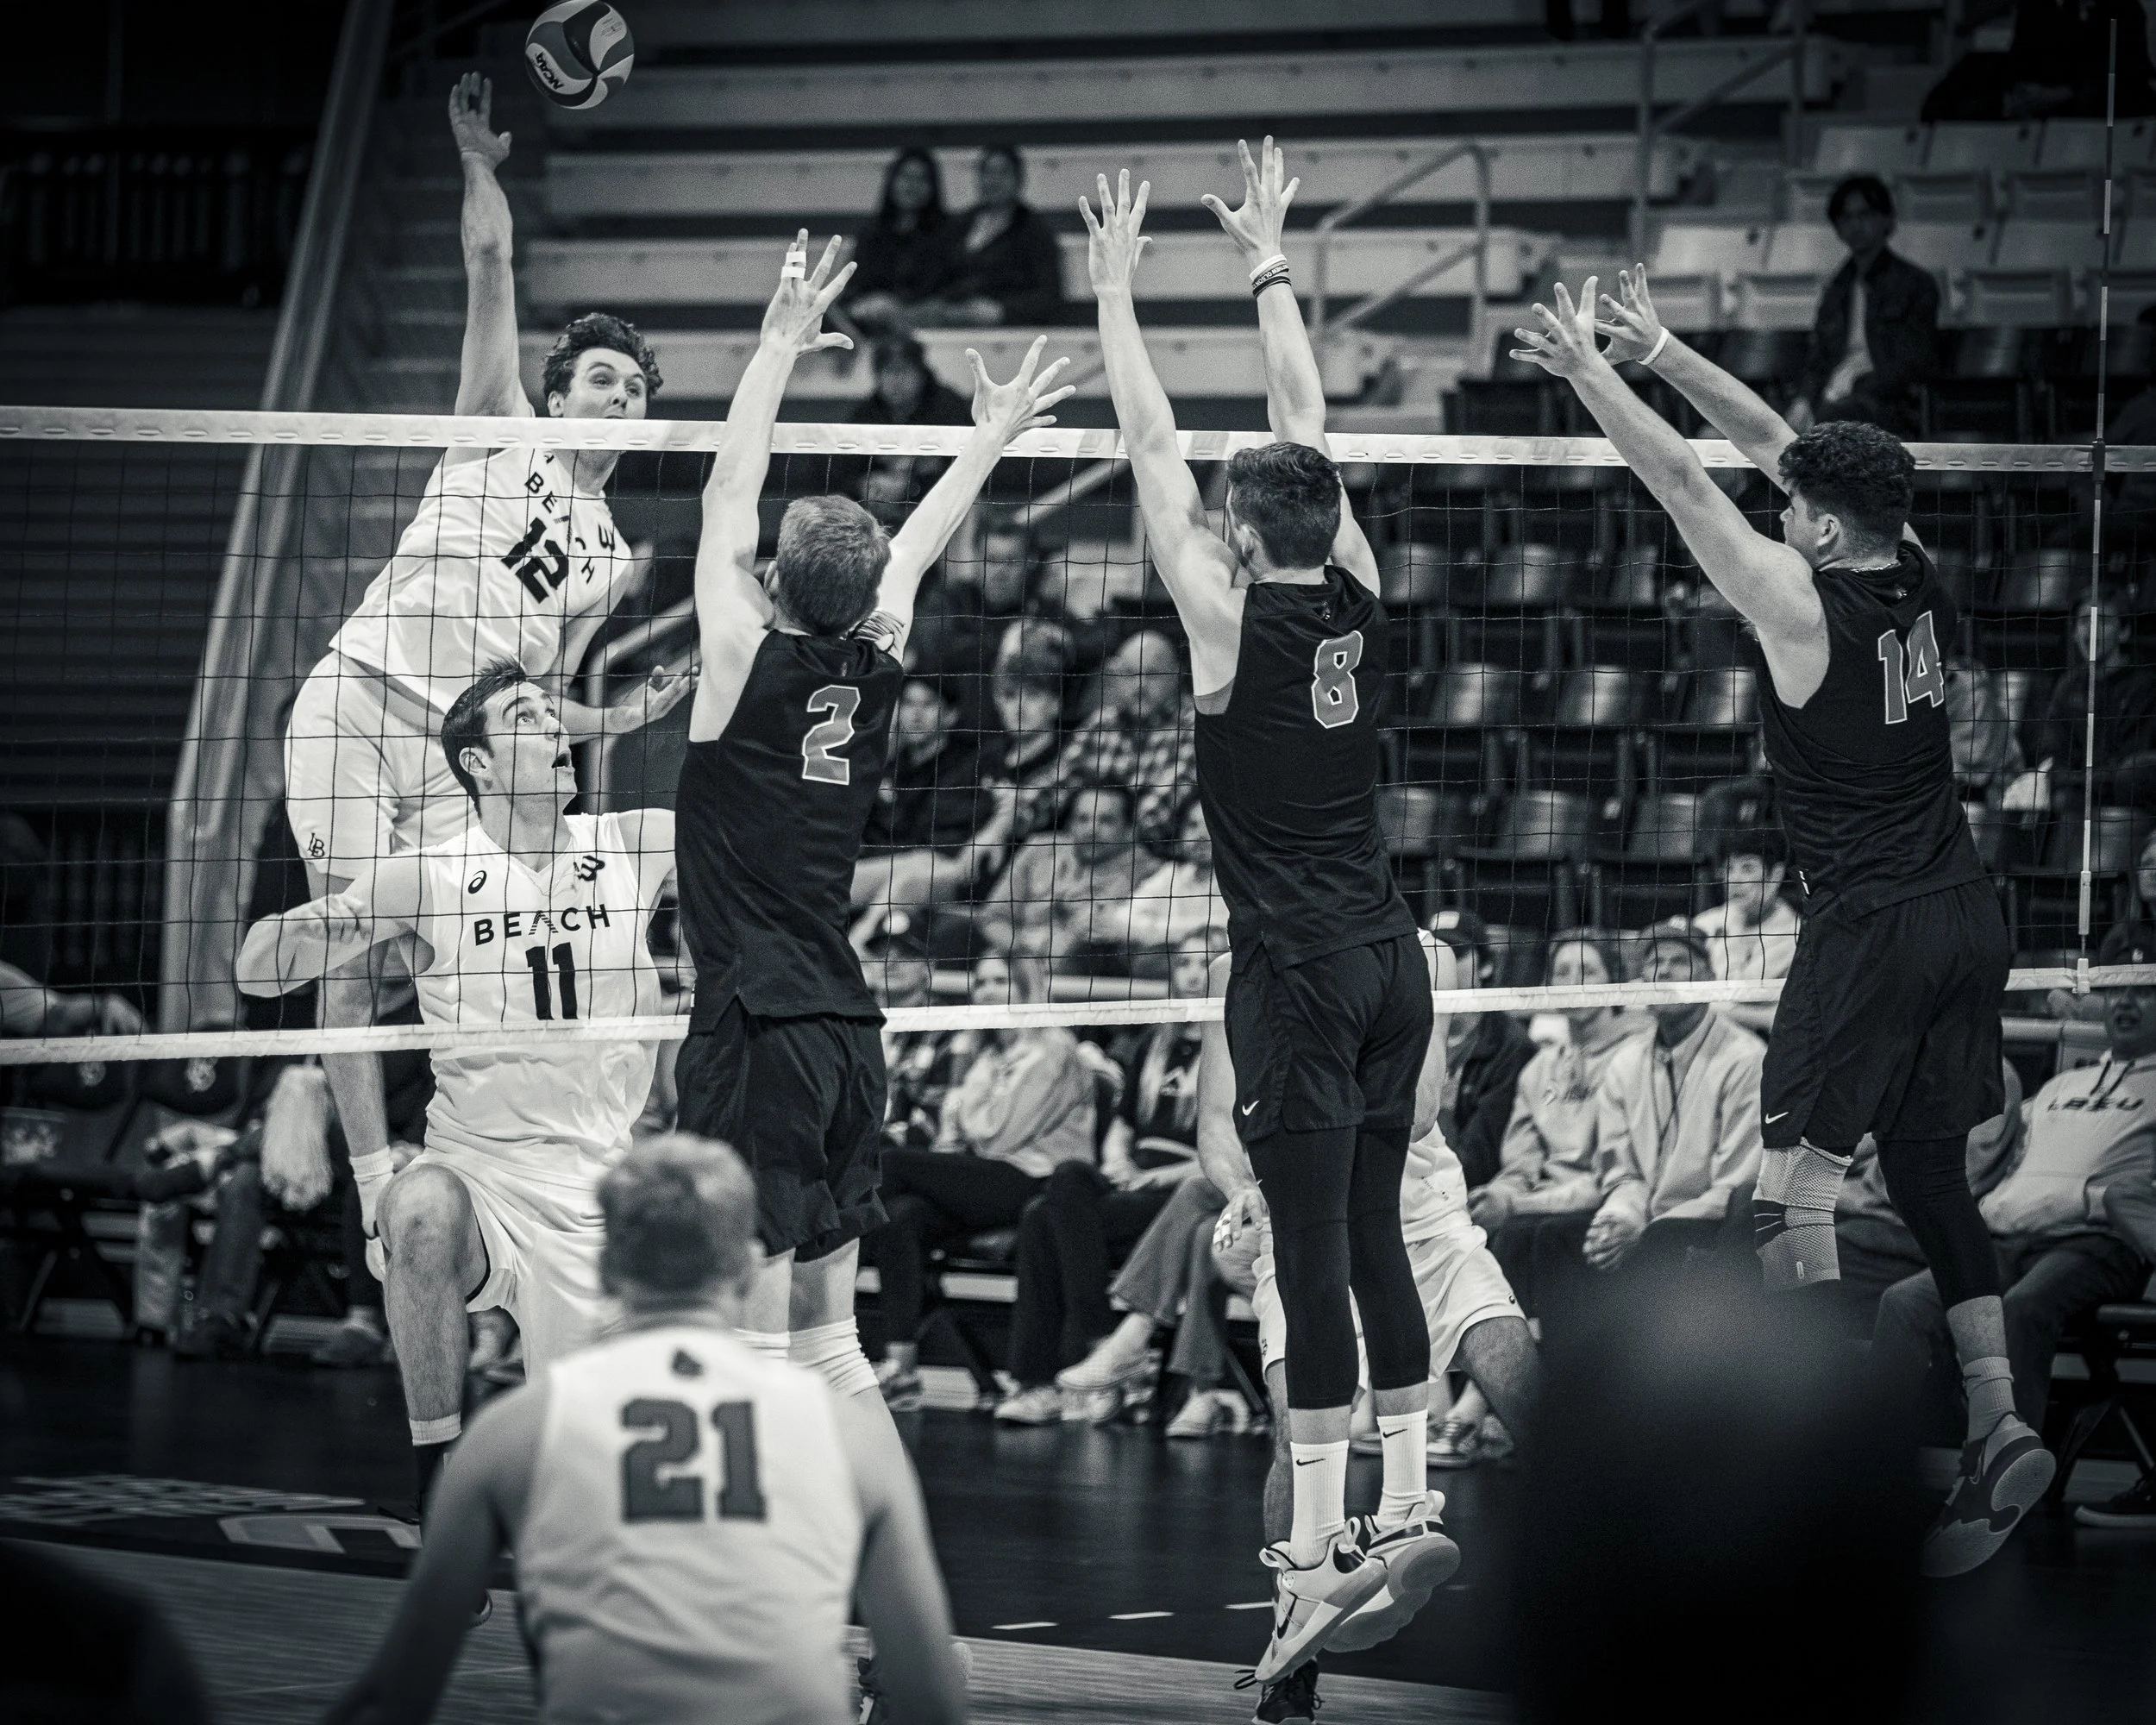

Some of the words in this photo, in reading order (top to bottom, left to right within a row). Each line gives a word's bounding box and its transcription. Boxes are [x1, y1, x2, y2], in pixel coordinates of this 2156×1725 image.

[536, 51, 564, 91] NCAA
[500, 517, 570, 604] 12
[1311, 630, 1363, 729] 8
[1877, 610, 1945, 724] 14
[802, 684, 861, 786] 2
[474, 903, 611, 946] BEACH
[525, 942, 579, 1020] 11
[620, 1397, 768, 1525] 21
